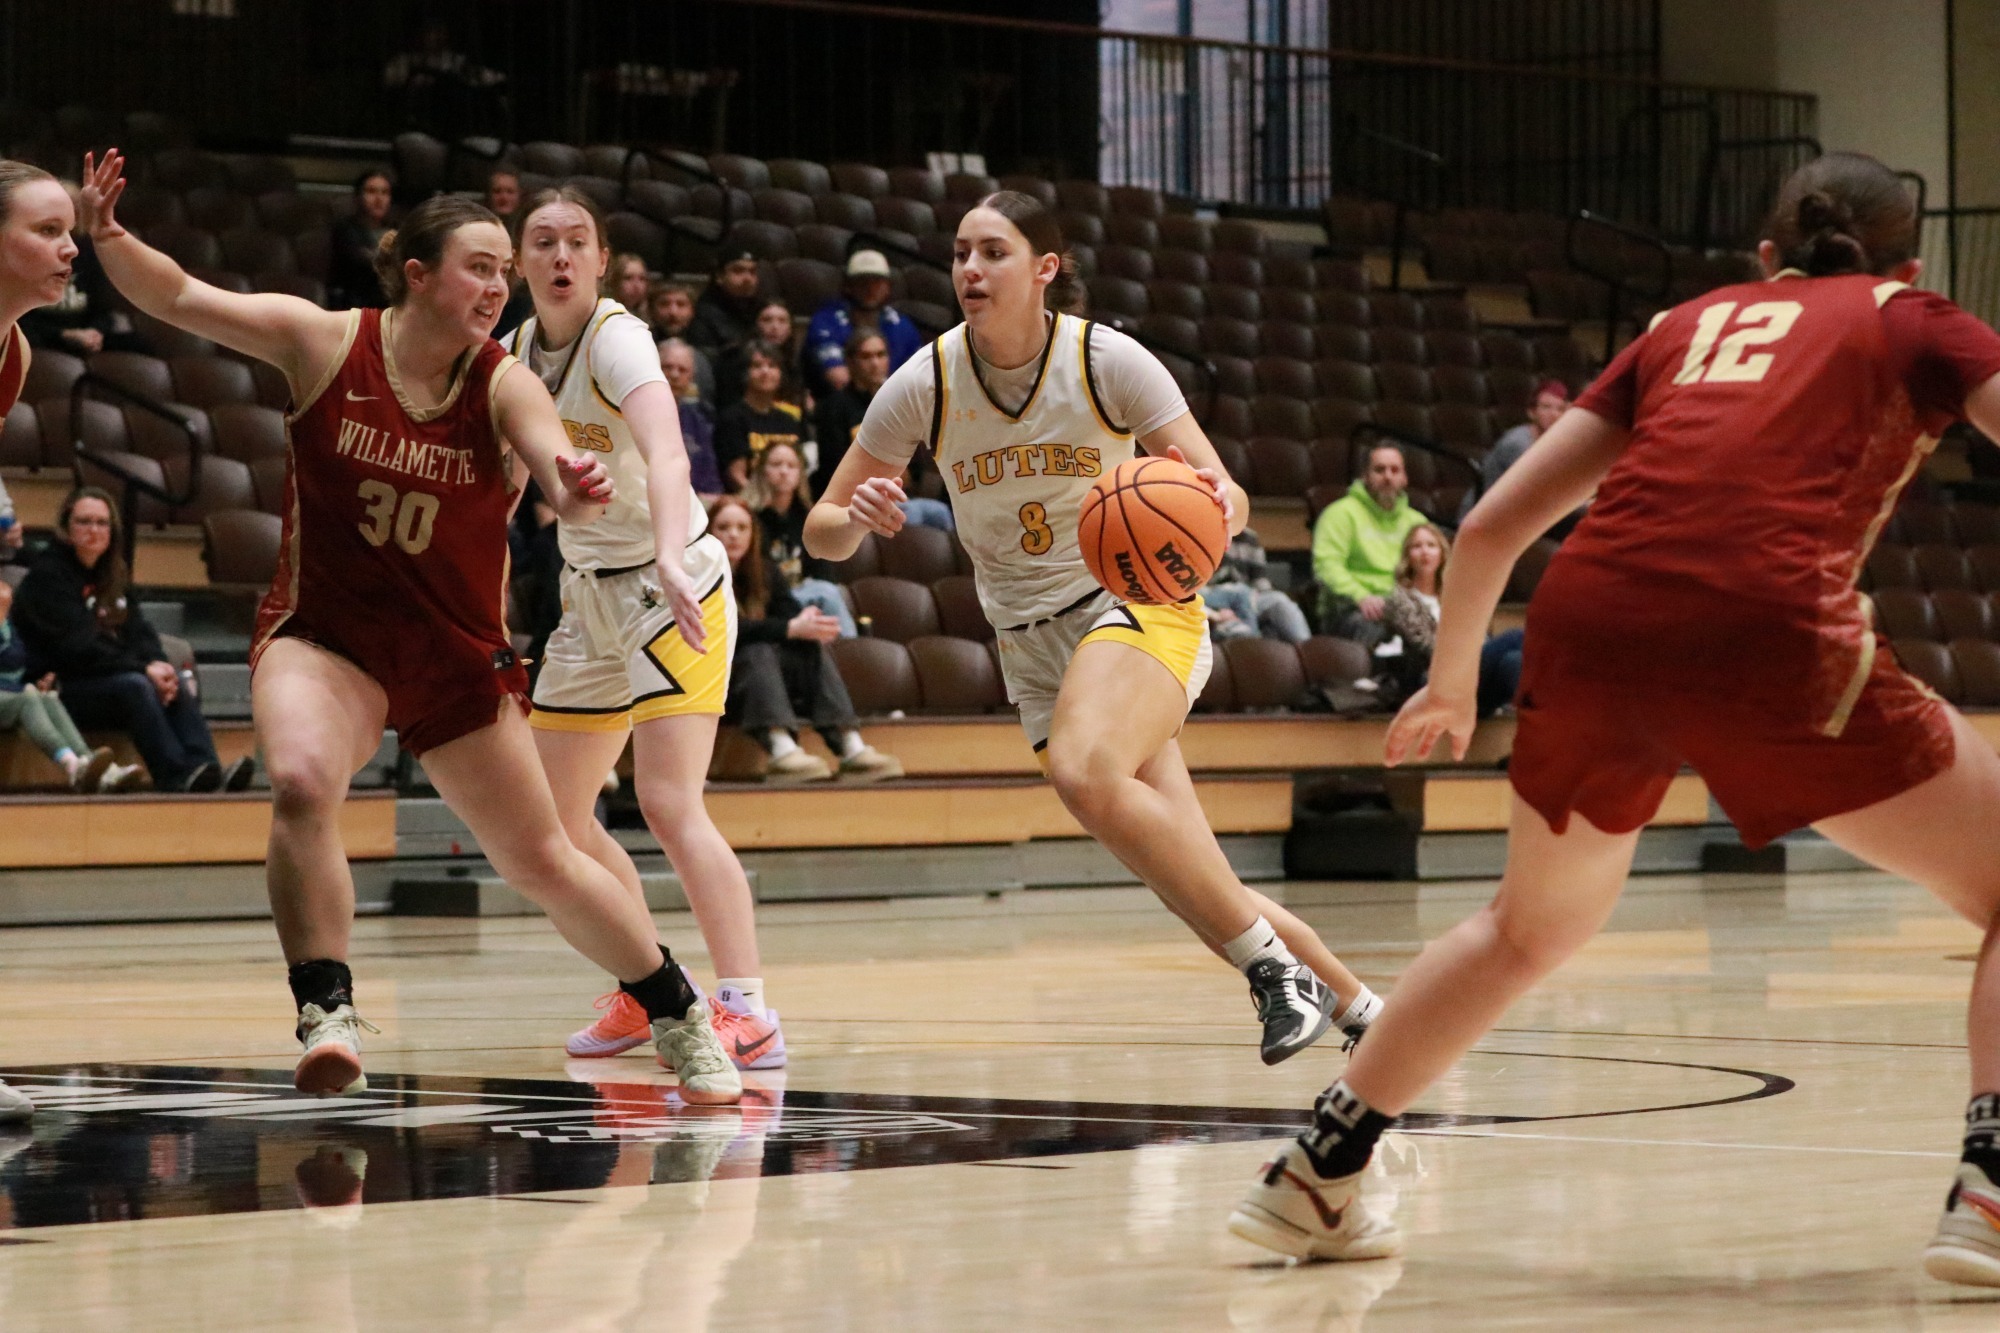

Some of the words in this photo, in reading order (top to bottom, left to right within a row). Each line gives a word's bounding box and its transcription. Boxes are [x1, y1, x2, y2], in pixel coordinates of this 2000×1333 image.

[1672, 301, 1805, 385] 12
[336, 417, 476, 485] WILLAMETTE
[951, 443, 1102, 494] LUTES
[357, 478, 440, 555] 30
[1154, 541, 1204, 593] NCAA
